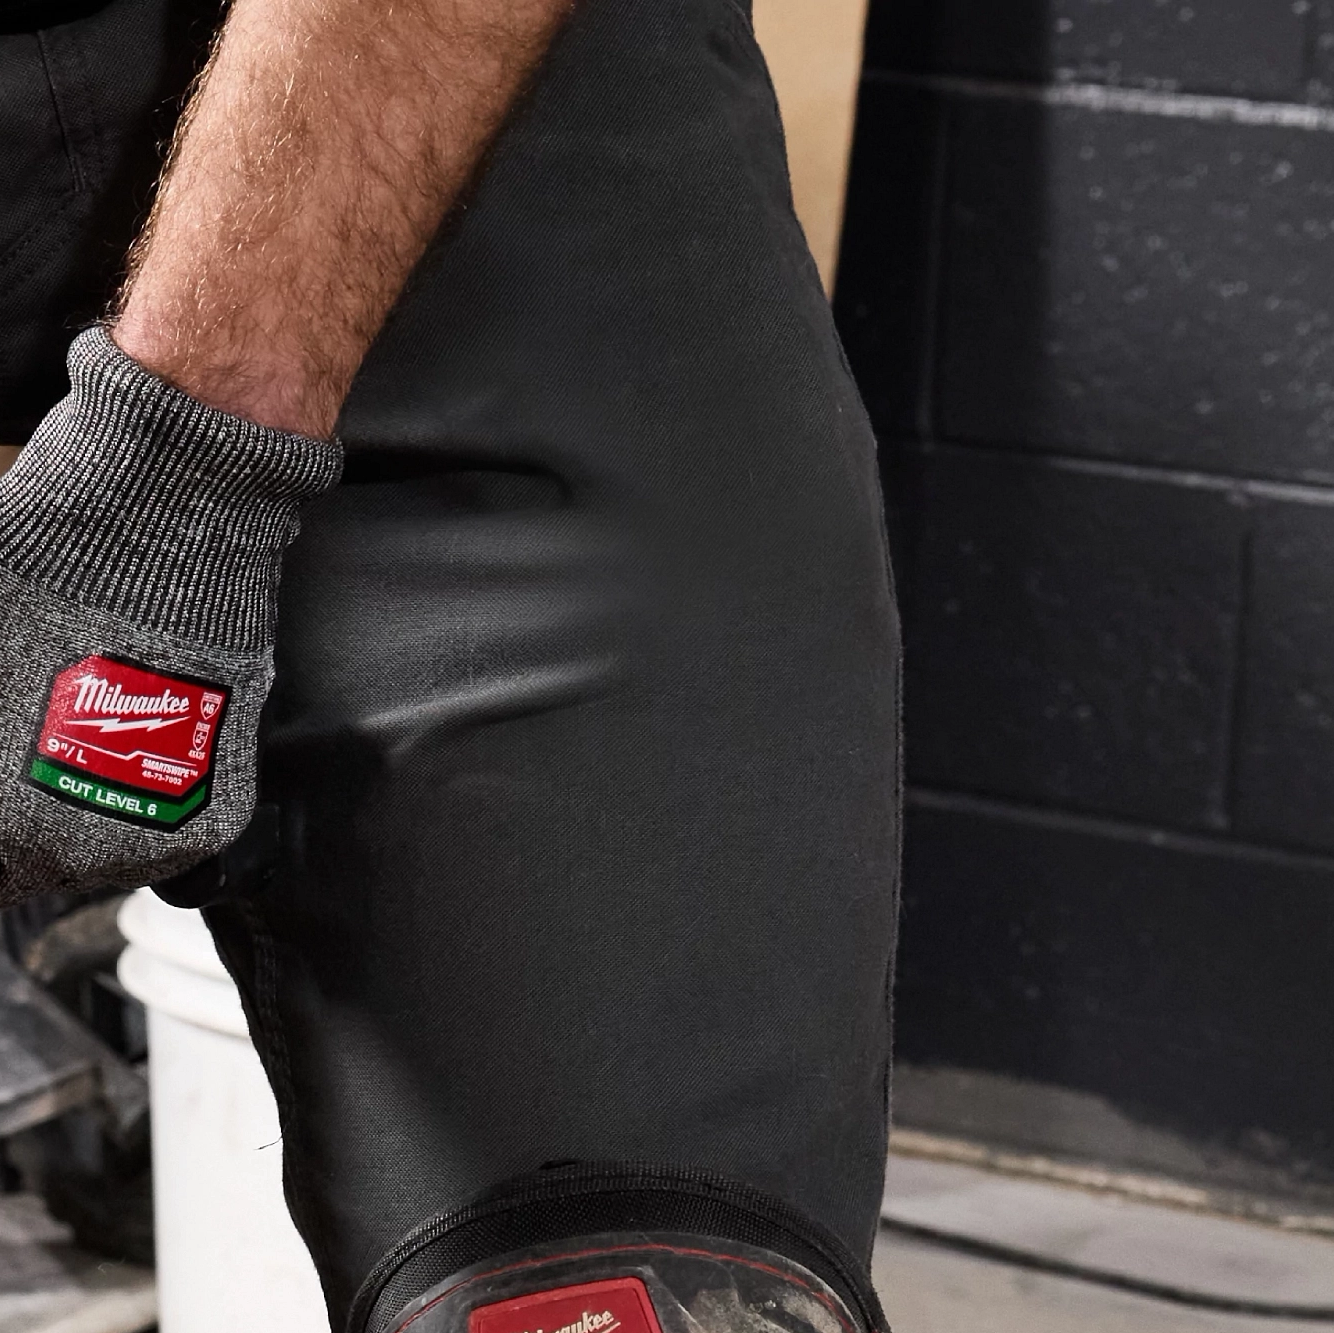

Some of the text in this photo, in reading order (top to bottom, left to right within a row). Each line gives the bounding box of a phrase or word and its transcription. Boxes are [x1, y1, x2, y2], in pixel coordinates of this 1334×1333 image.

[73, 673, 190, 715] Milwaukee
[58, 776, 157, 815] CUT LEVEL 6
